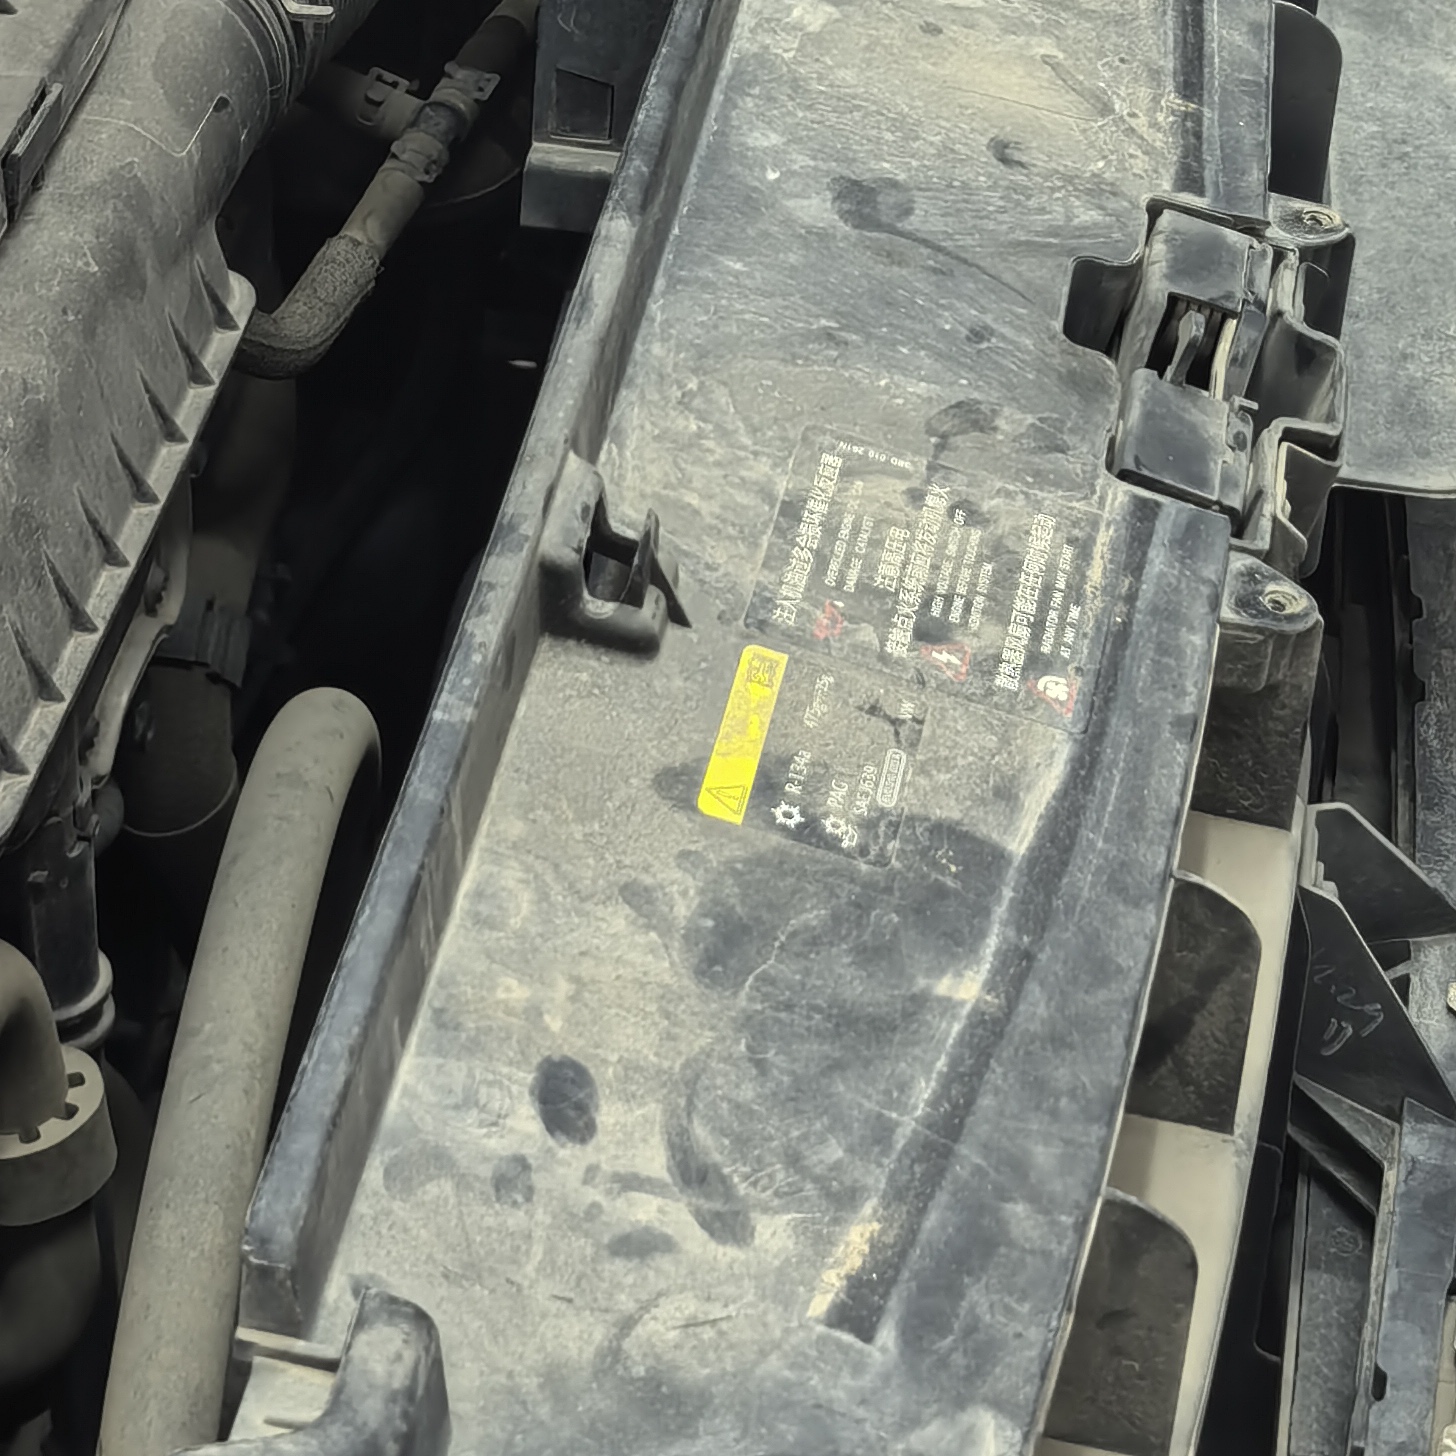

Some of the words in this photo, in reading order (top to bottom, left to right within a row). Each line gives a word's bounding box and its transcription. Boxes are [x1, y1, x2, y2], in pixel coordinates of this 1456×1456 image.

[872, 523, 912, 592] 注意高压电
[927, 594, 945, 618] HIGH
[951, 507, 968, 526] OFF
[1057, 542, 1076, 571] START
[1053, 569, 1069, 590] MAY
[947, 593, 966, 624] ENGINE
[1049, 589, 1065, 609] FAN
[1065, 602, 1082, 624] TIME
[1037, 608, 1062, 655] RADIATOR
[1061, 624, 1077, 645] ANY
[1058, 645, 1072, 659] AT
[783, 747, 813, 795] R-134a
[825, 778, 850, 810] PAG
